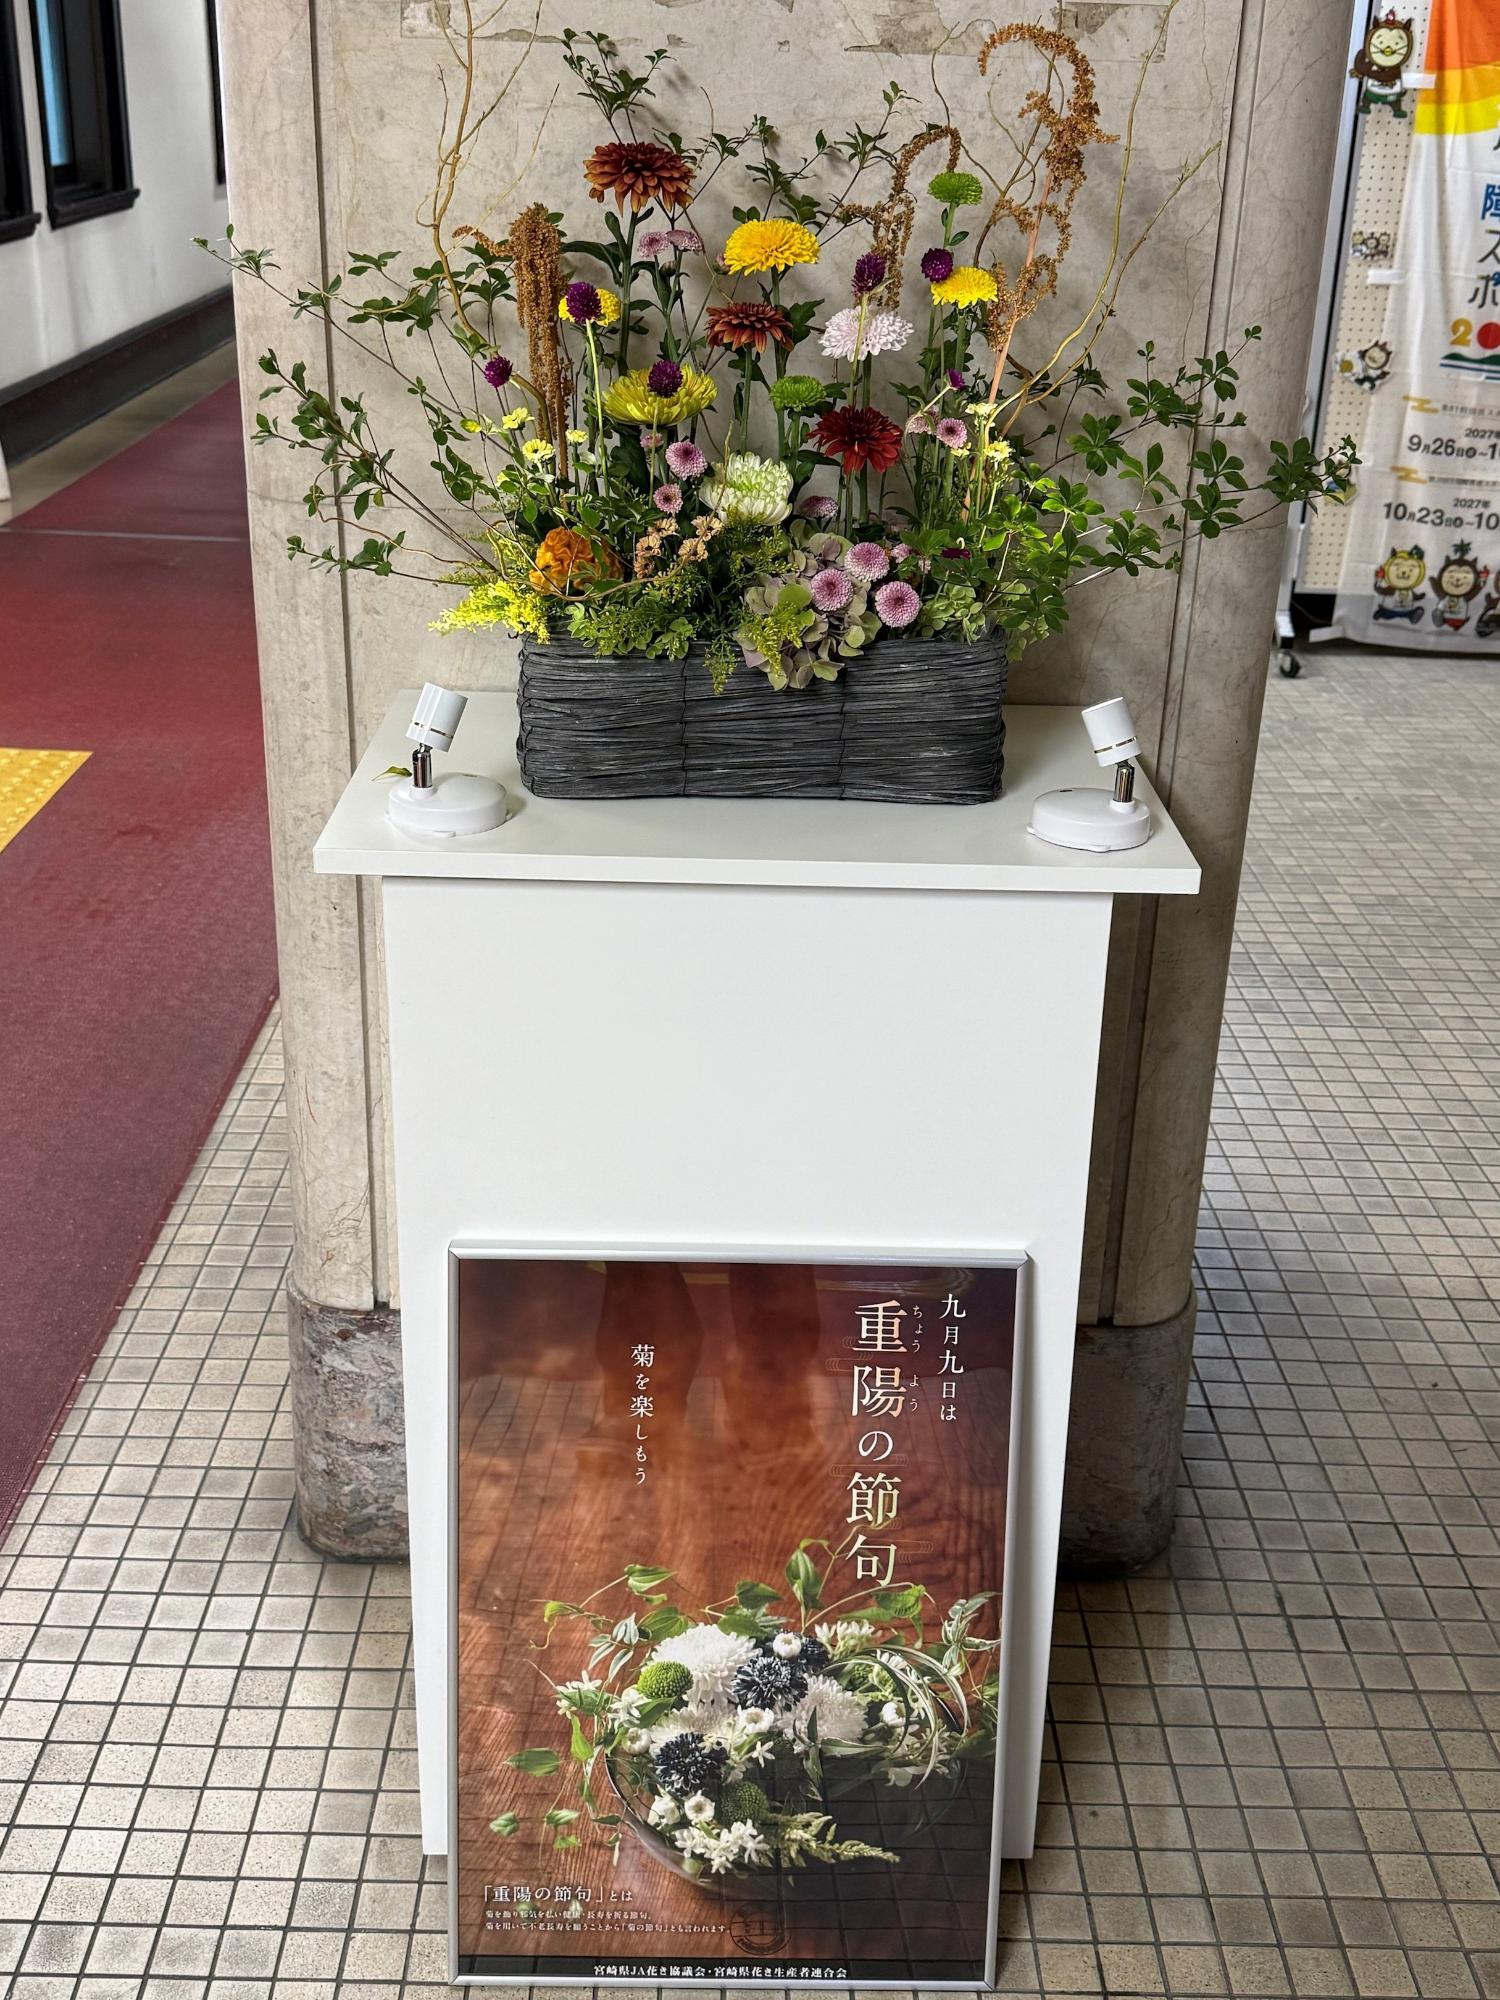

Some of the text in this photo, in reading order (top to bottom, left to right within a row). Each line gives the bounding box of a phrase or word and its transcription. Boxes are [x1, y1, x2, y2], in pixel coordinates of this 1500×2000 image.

[1453, 497, 1491, 509] 2027年
[908, 1304, 924, 1412] ちょう よう
[936, 1293, 967, 1421] 九月九日は
[629, 1343, 655, 1486] 菊を楽しもう
[845, 1299, 909, 1587] 重陽の節句
[483, 1885, 634, 1903] 「重陽の節句」とは
[593, 1965, 848, 1979] 宮崎県JA花き協議会・宮崎県花き生産者連合会
